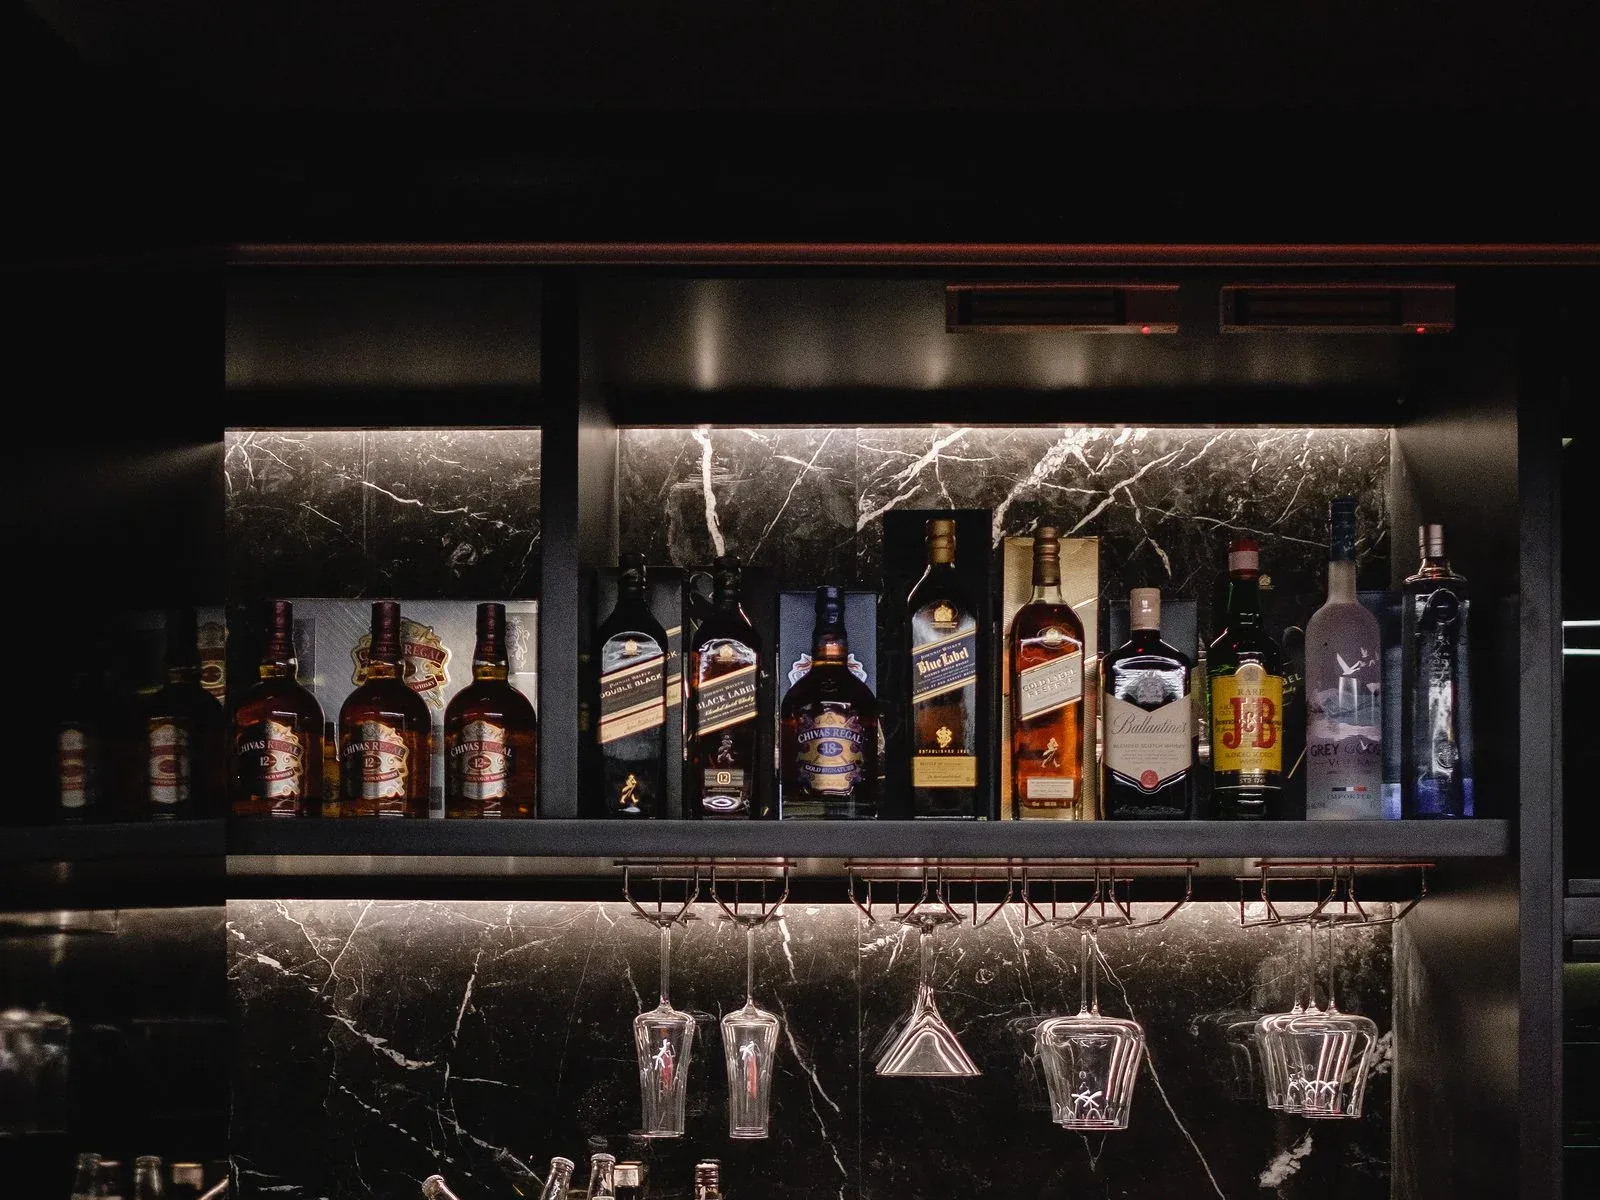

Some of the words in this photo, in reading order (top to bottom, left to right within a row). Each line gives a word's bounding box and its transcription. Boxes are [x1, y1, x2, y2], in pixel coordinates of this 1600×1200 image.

[915, 659, 942, 676] Blue
[940, 646, 970, 667] Label
[634, 673, 662, 687] BLACK
[1237, 688, 1265, 696] RARE
[797, 728, 830, 744] CHIVAS
[832, 728, 861, 744] REGAL
[240, 741, 265, 754] HIVAS
[451, 741, 479, 757] CHIVAS
[823, 742, 837, 754] 18
[1310, 743, 1340, 757] GREY
[260, 756, 270, 766] 12
[365, 757, 374, 768] 12
[474, 758, 485, 768] 12
[720, 774, 729, 782] 12
